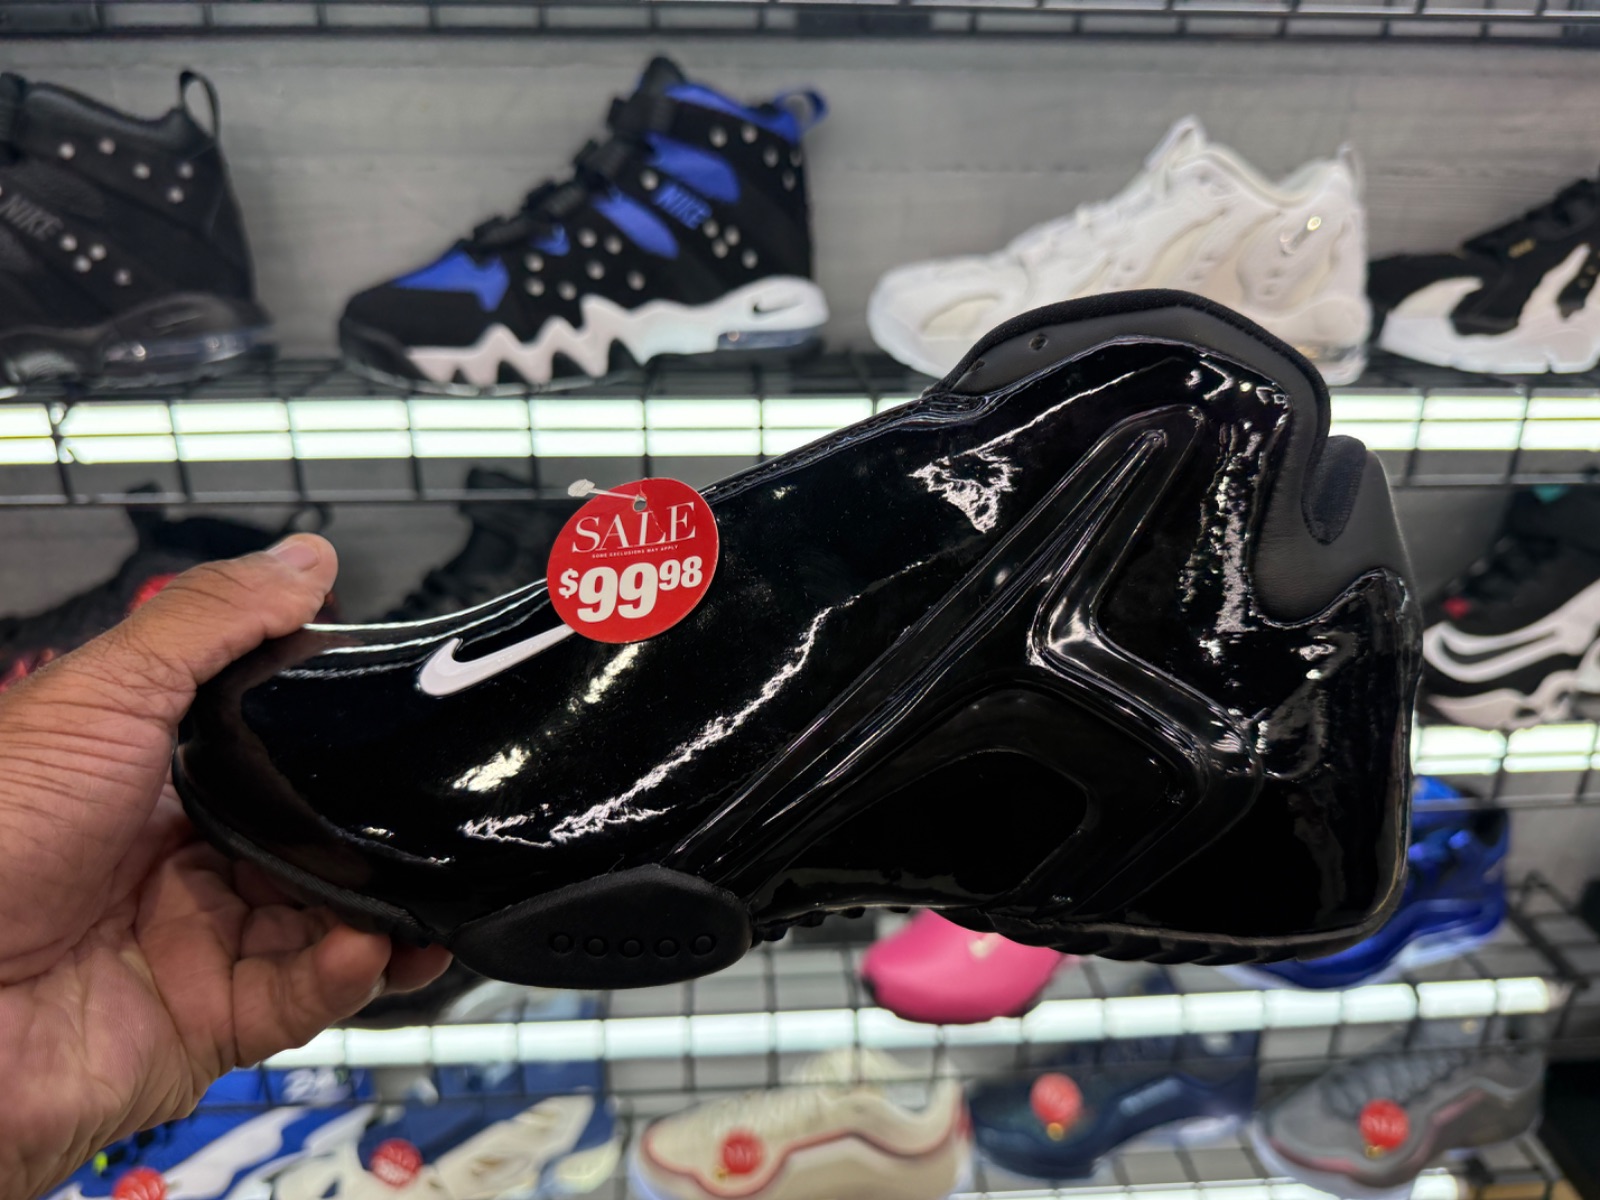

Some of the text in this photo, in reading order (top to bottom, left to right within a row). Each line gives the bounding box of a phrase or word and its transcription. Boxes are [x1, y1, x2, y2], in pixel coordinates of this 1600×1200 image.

[0, 193, 64, 241] NIKE
[655, 184, 713, 231] NIKE
[572, 502, 696, 553] SALE
[609, 549, 645, 557] EXCLUSIONS
